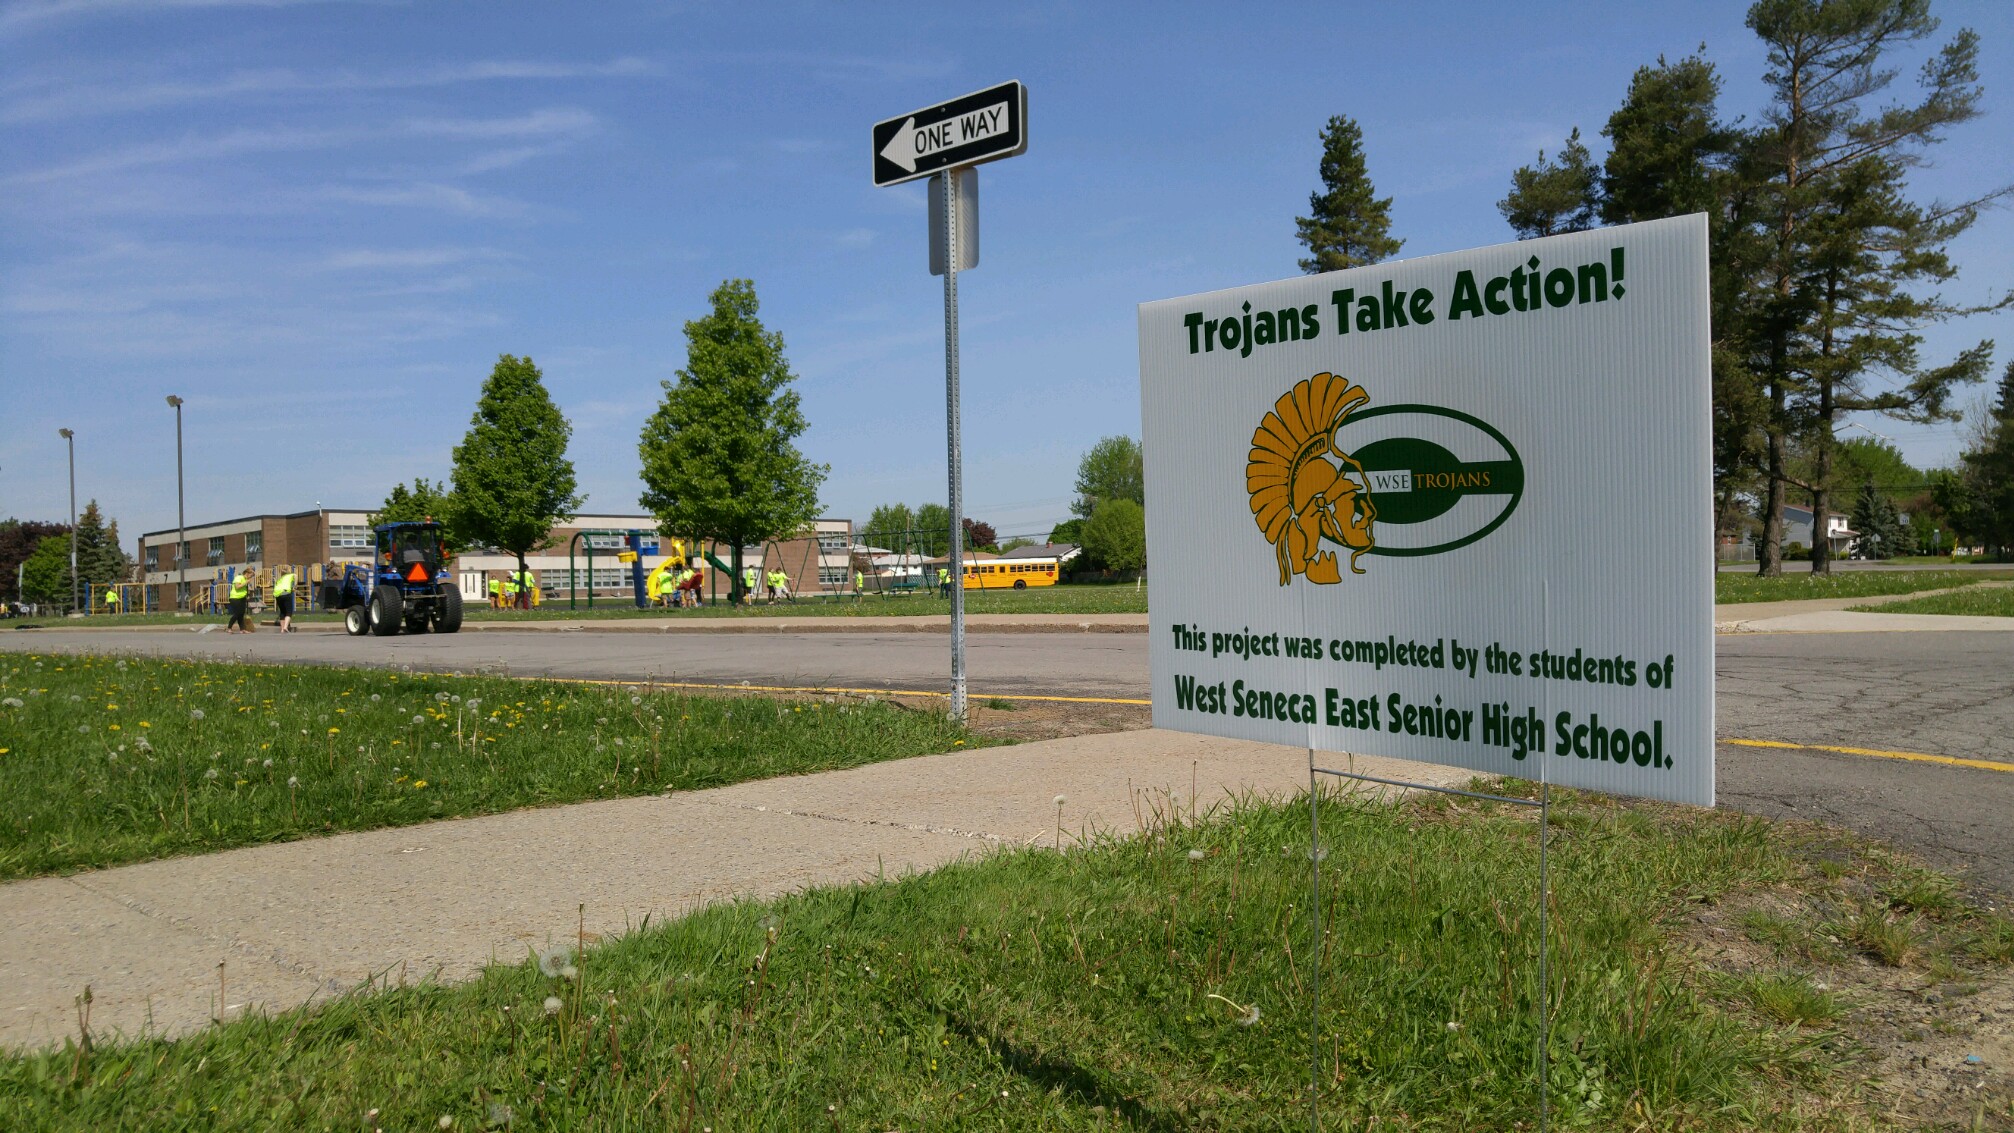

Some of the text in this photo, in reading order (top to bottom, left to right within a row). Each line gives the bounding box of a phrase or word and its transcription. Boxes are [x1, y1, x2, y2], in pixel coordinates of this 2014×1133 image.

[915, 106, 1002, 154] ONE WAY
[1184, 247, 1625, 358] Trojans Take Action!
[1376, 471, 1491, 491] WSE TROJANS
[1172, 623, 1674, 690] This project was completed by the students of
[1175, 675, 1673, 770] West Seneca East Senior High School.
